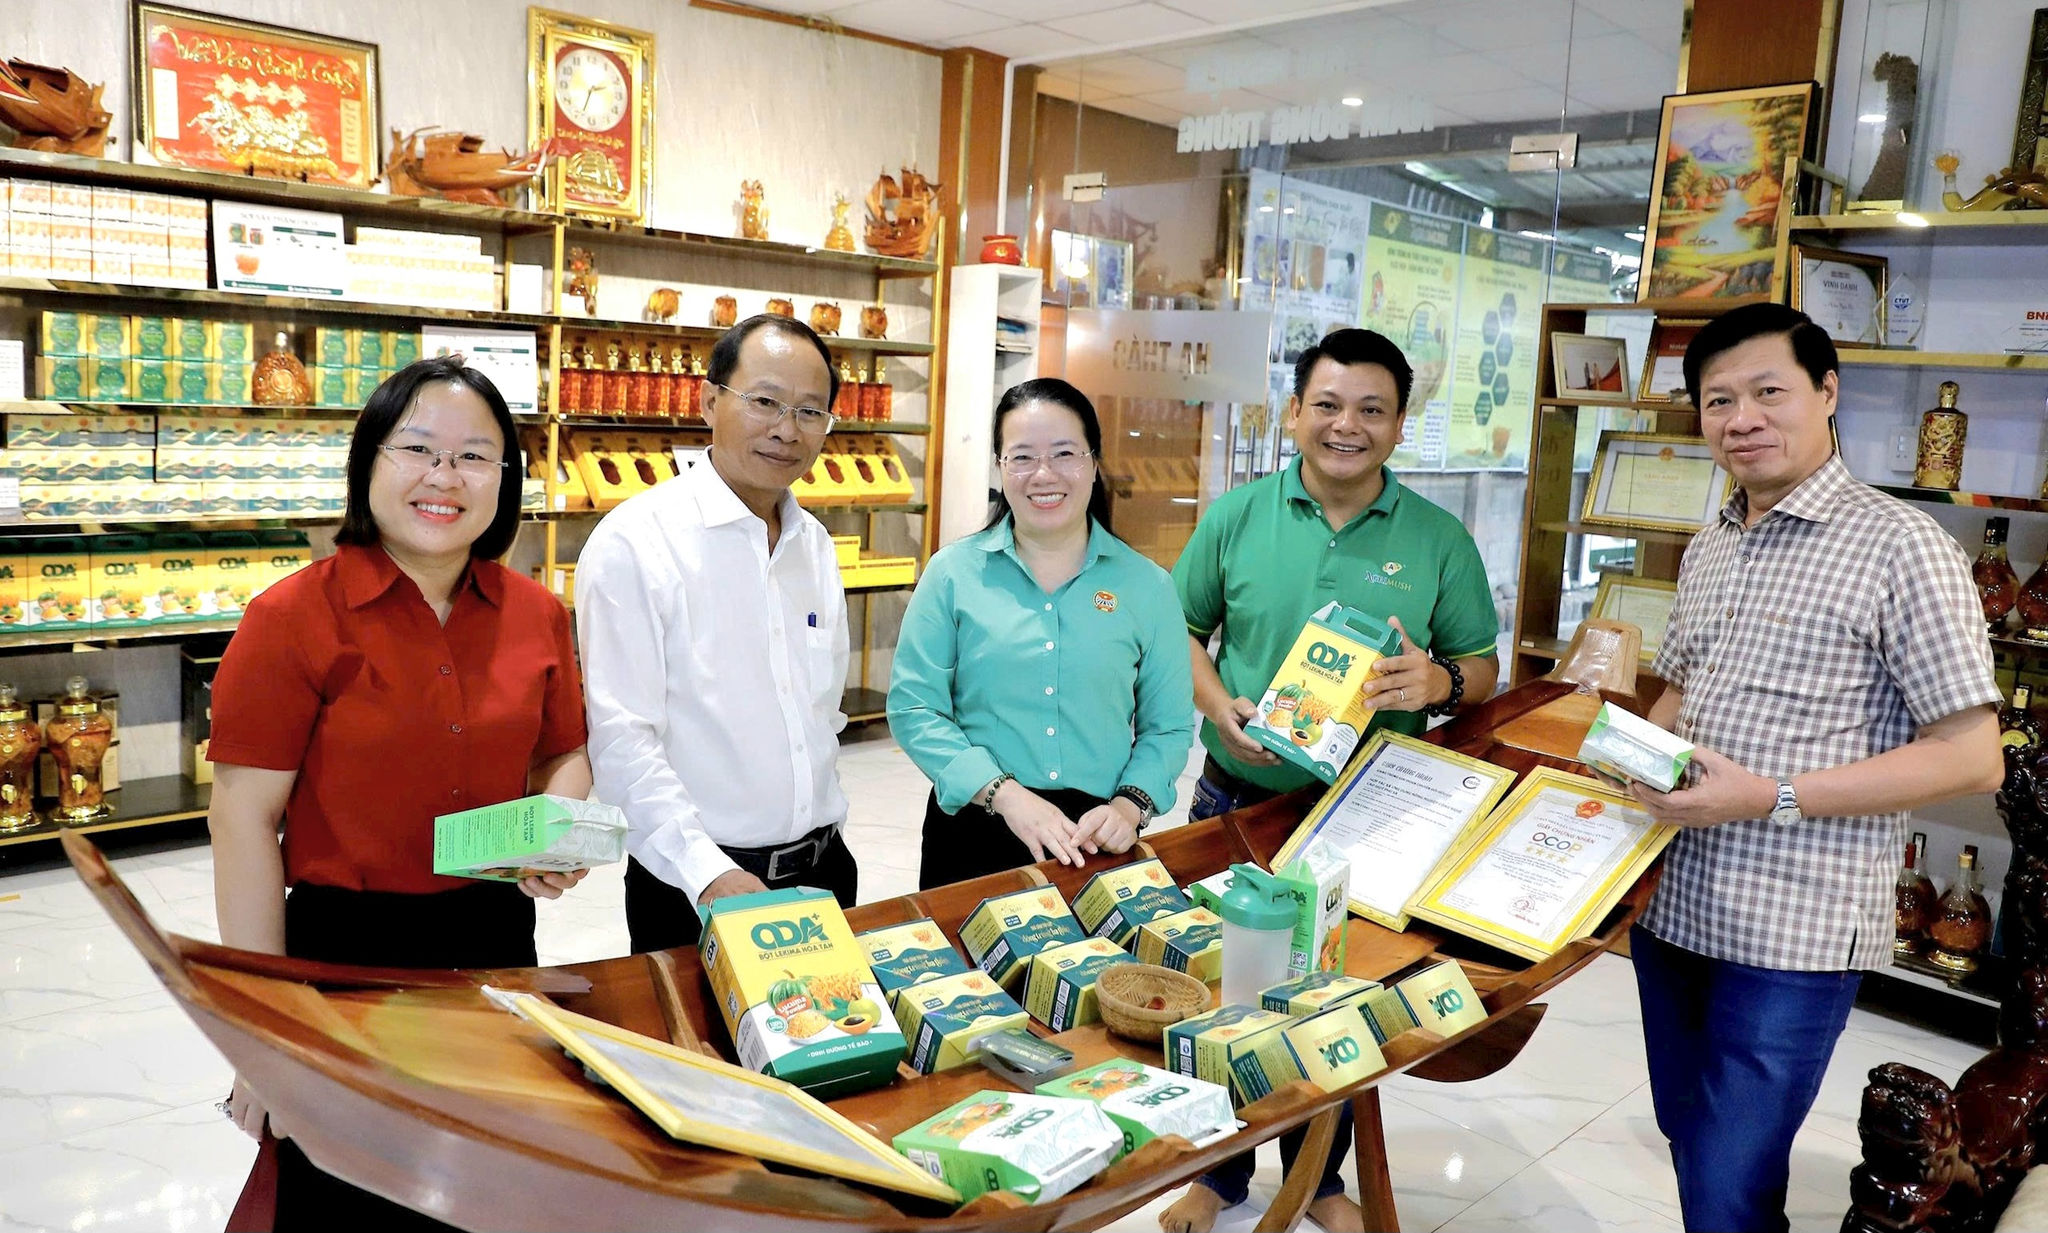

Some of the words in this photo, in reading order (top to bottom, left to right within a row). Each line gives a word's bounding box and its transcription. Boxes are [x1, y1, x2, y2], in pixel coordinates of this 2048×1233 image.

[1823, 280, 1839, 290] VINH
[1840, 281, 1858, 292] DANH
[1532, 832, 1583, 853] OCOP
[758, 951, 774, 961] BỘT
[775, 947, 801, 959] LEKIMA
[801, 943, 819, 953] HÒA
[820, 942, 834, 950] TAN
[777, 996, 807, 1014] Lucuma
[785, 1002, 807, 1016] Powder
[810, 1049, 826, 1058] DINH
[826, 1044, 848, 1055] DƯỠNG
